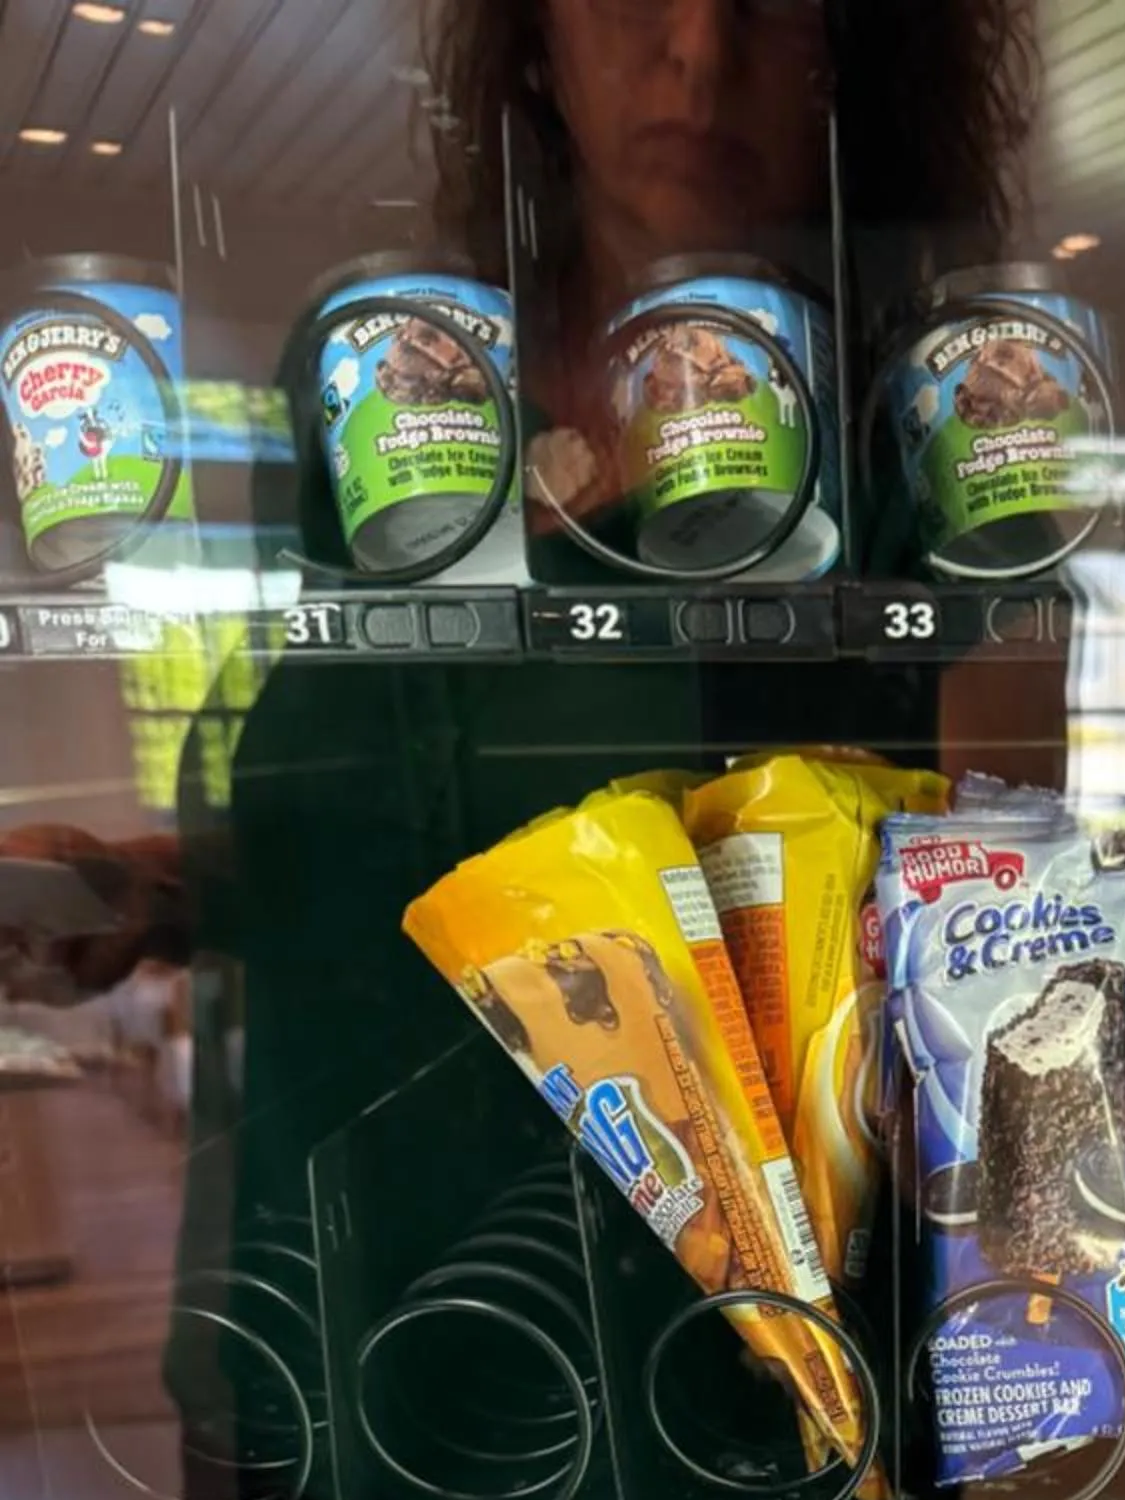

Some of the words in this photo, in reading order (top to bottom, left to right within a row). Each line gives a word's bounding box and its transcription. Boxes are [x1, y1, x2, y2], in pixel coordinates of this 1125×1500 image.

[42, 325, 122, 354] JERRY'S
[932, 336, 972, 373] BEN
[20, 361, 105, 402] Cherry
[394, 410, 484, 429] Chocolate
[660, 410, 742, 439] Chocolate
[376, 430, 429, 453] Fudge
[431, 426, 500, 445] Browni
[690, 426, 766, 446] Brownie
[972, 428, 1056, 453] Chocolate
[957, 453, 1005, 479] Fudge
[283, 609, 332, 644] 31
[569, 604, 623, 640] 32
[884, 602, 936, 639] 33
[75, 632, 108, 648] For
[903, 845, 962, 866] GOOD
[906, 858, 978, 885] HUMOR
[945, 894, 1103, 944] Cookies
[948, 944, 977, 981] &
[981, 926, 1115, 969] Creme
[928, 1333, 992, 1352] LOADED
[930, 1352, 1002, 1368] Chocolate
[932, 1367, 980, 1384] Cookie
[983, 1360, 1061, 1380] Crumbles!
[935, 1387, 991, 1407] FROZEN
[993, 1382, 1057, 1403] COOKIES
[1059, 1378, 1092, 1397] AND
[937, 1406, 985, 1427] CREME
[987, 1401, 1049, 1423] DESSERT
[1052, 1396, 1081, 1416] BAR
